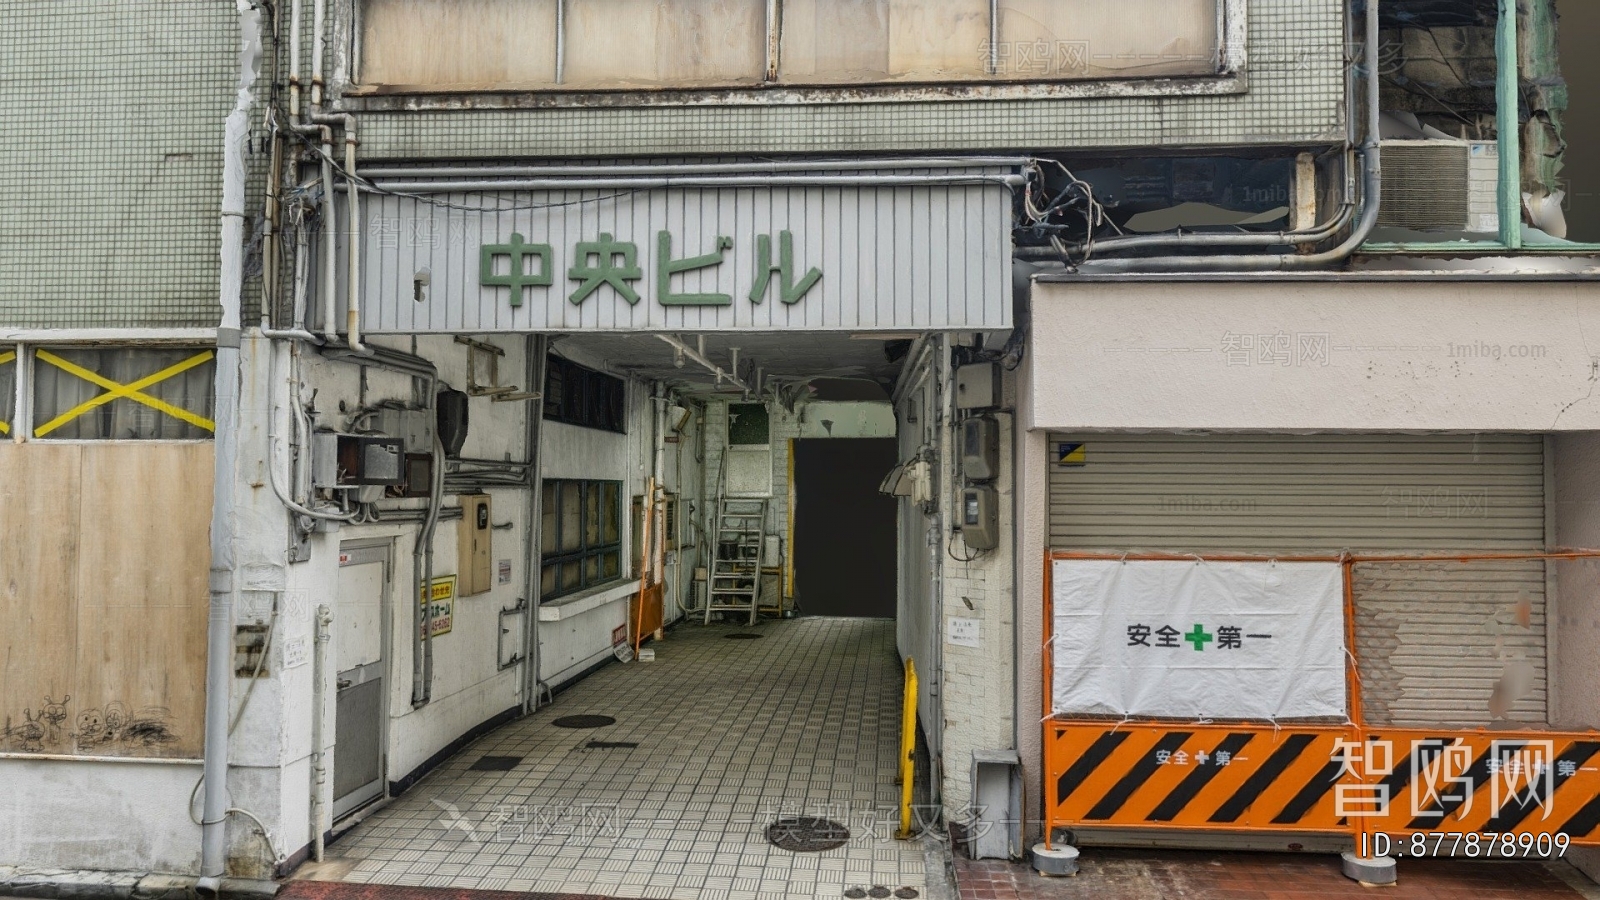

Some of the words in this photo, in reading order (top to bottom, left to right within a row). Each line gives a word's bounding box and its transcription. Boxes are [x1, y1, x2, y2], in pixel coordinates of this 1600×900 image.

[481, 230, 823, 307] 中央ビル
[1127, 624, 1181, 647] 安全
[1217, 625, 1272, 649] 第一
[1156, 750, 1189, 765] 安全
[1215, 750, 1249, 766] 第一
[1556, 759, 1598, 777] 第一
